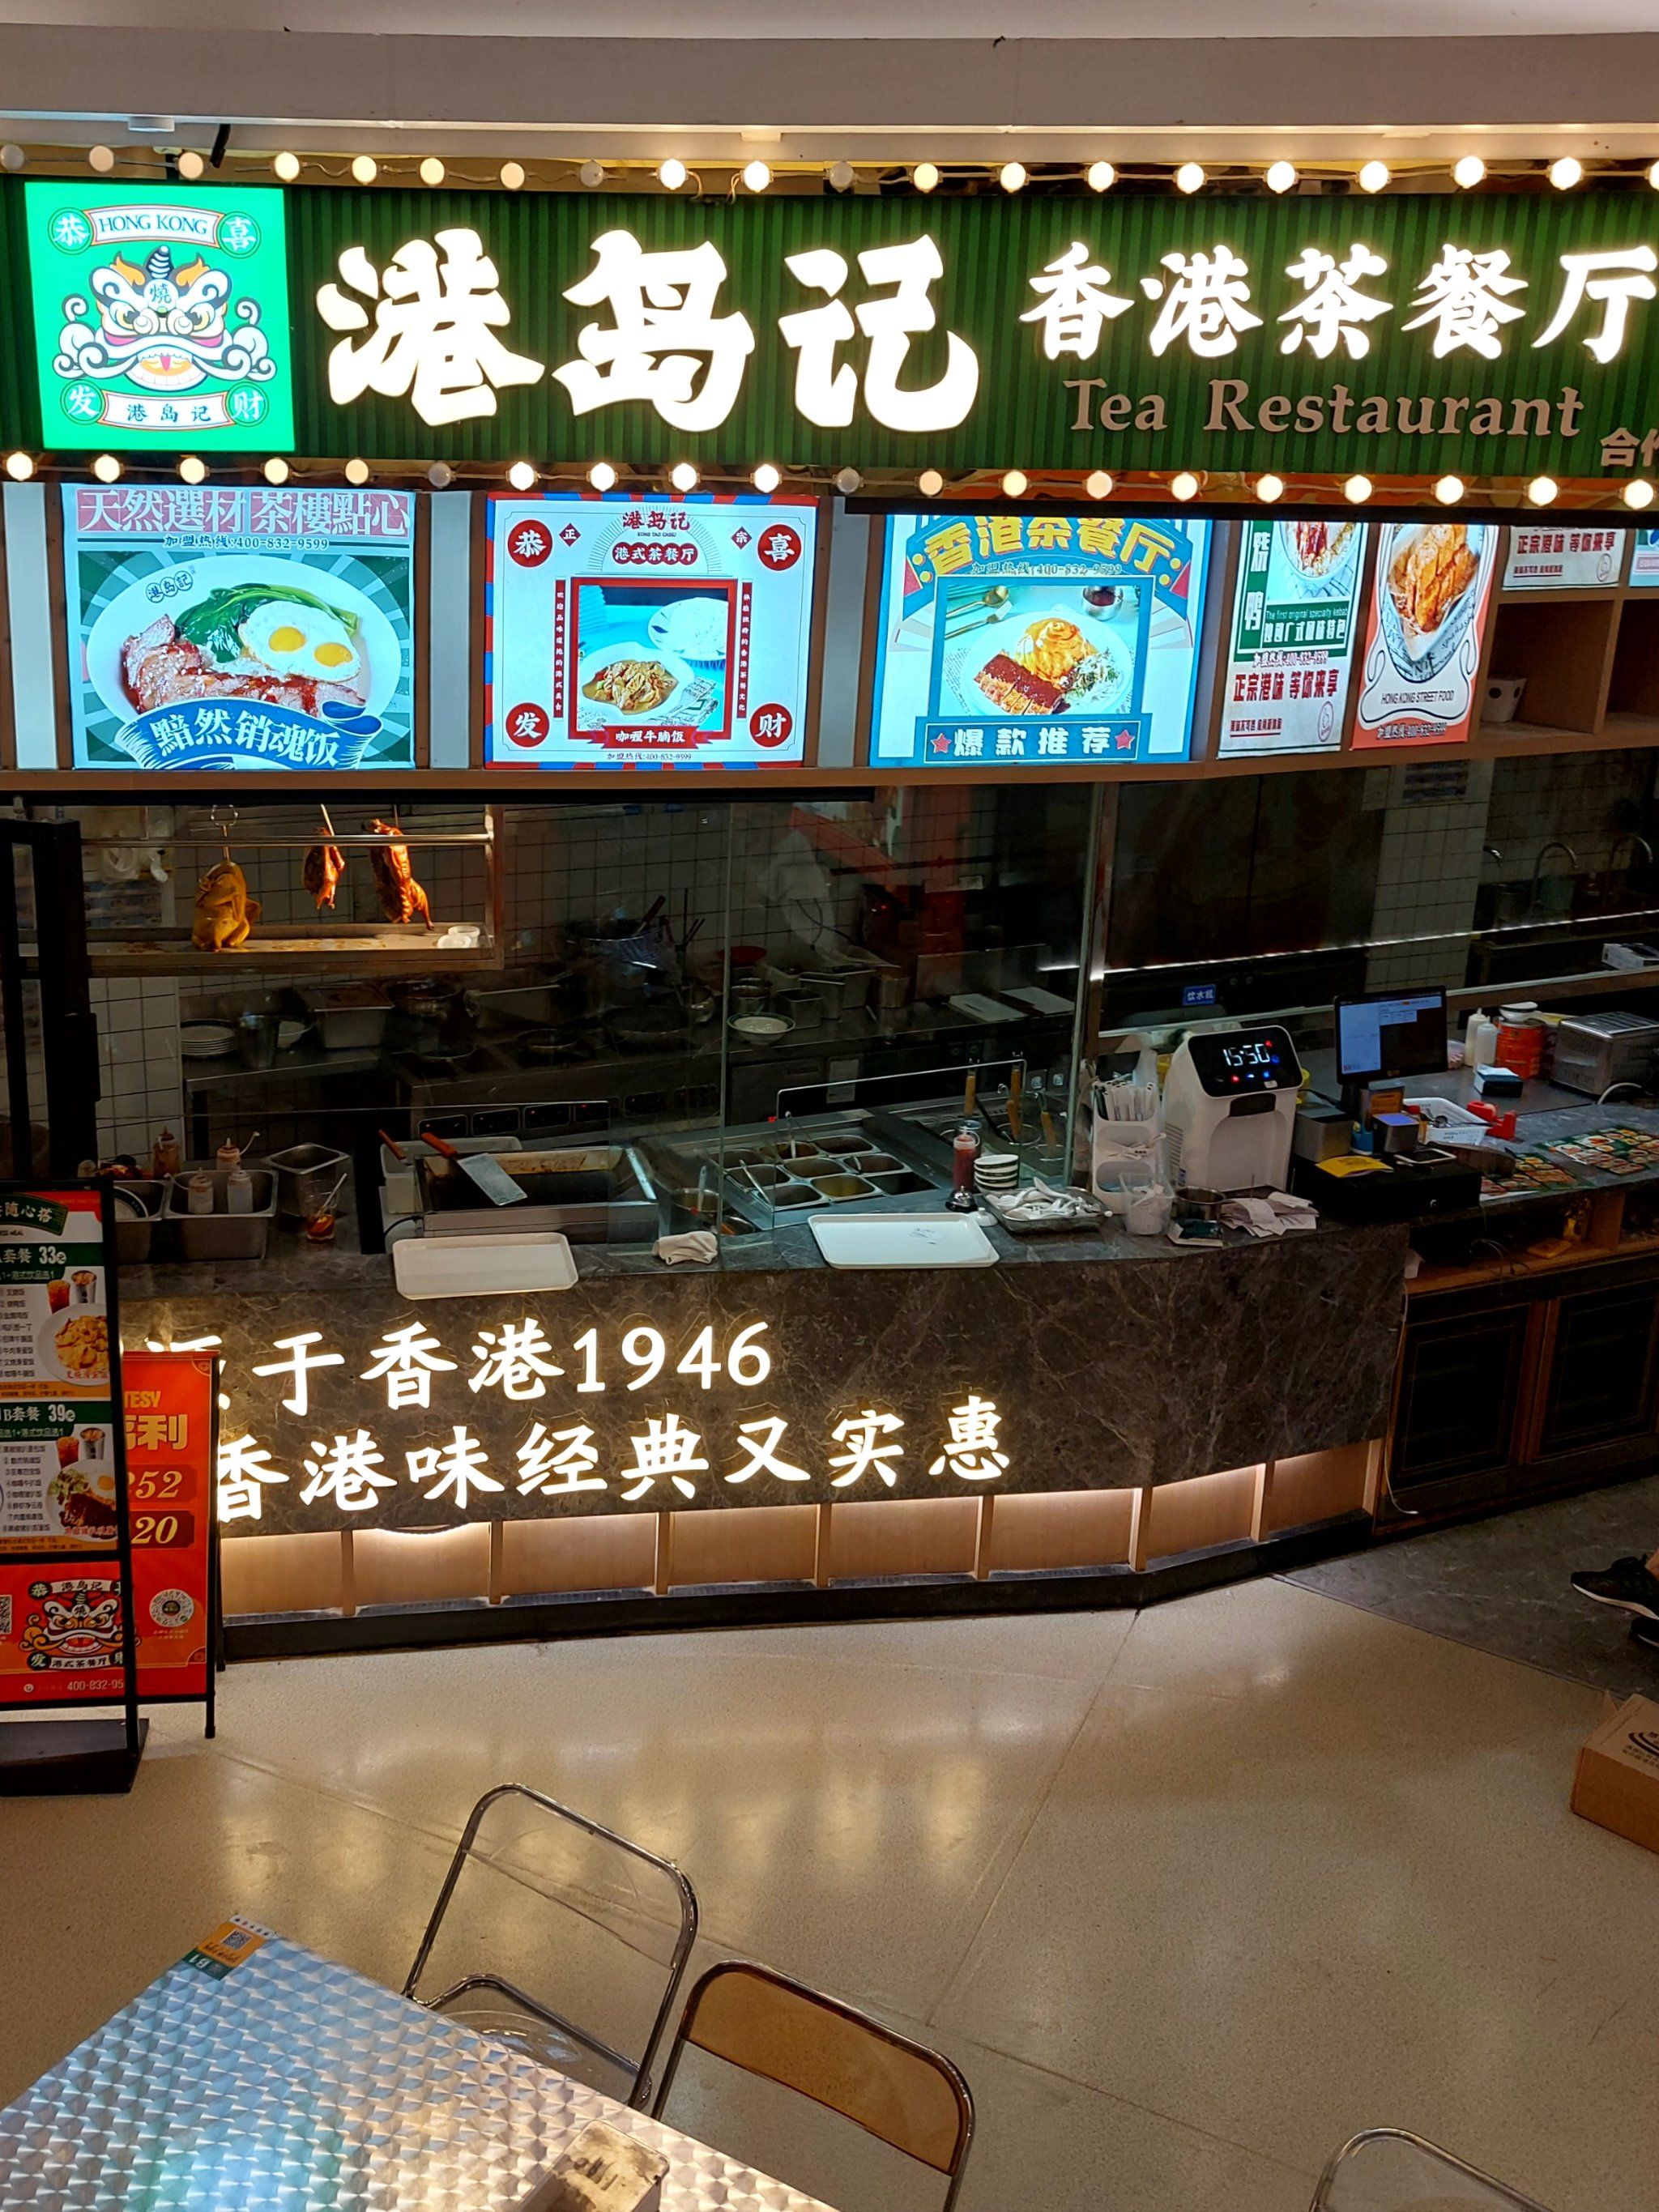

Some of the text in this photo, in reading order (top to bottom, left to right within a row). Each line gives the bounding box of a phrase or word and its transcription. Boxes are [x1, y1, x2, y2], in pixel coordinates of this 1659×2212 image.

[53, 213, 87, 245] 恭
[98, 213, 208, 237] HONG KONG
[222, 215, 257, 252] 喜
[1019, 241, 1657, 364] 香港茶餐厅
[316, 228, 979, 432] 港岛记
[67, 385, 99, 418] 发
[126, 403, 212, 424] 港岛记
[232, 389, 265, 420] 财
[1063, 377, 1584, 437] Tea Restaurant
[79, 489, 410, 537] 天然選材 茶樓點心
[622, 510, 691, 531] 港岛记
[514, 530, 547, 558] 恭
[563, 528, 578, 541] 正
[735, 531, 749, 544] 宗
[764, 533, 795, 563] 喜
[923, 515, 1175, 573] 香港茶餐厅
[615, 546, 695, 562] 港式茶餐厅
[1233, 671, 1285, 702] 正宗港味
[150, 706, 341, 768] 黯然销魂饭
[514, 711, 543, 739] 发
[615, 730, 685, 744] 咖喱牛腩饭
[755, 711, 787, 738] 财
[953, 727, 1111, 757] 爆款推荐
[0, 1201, 53, 1224] 随心搭
[0, 1248, 32, 1264] 套餐
[216, 1395, 1011, 1523] 香港味经典又实惠
[130, 1515, 177, 1545] 20
